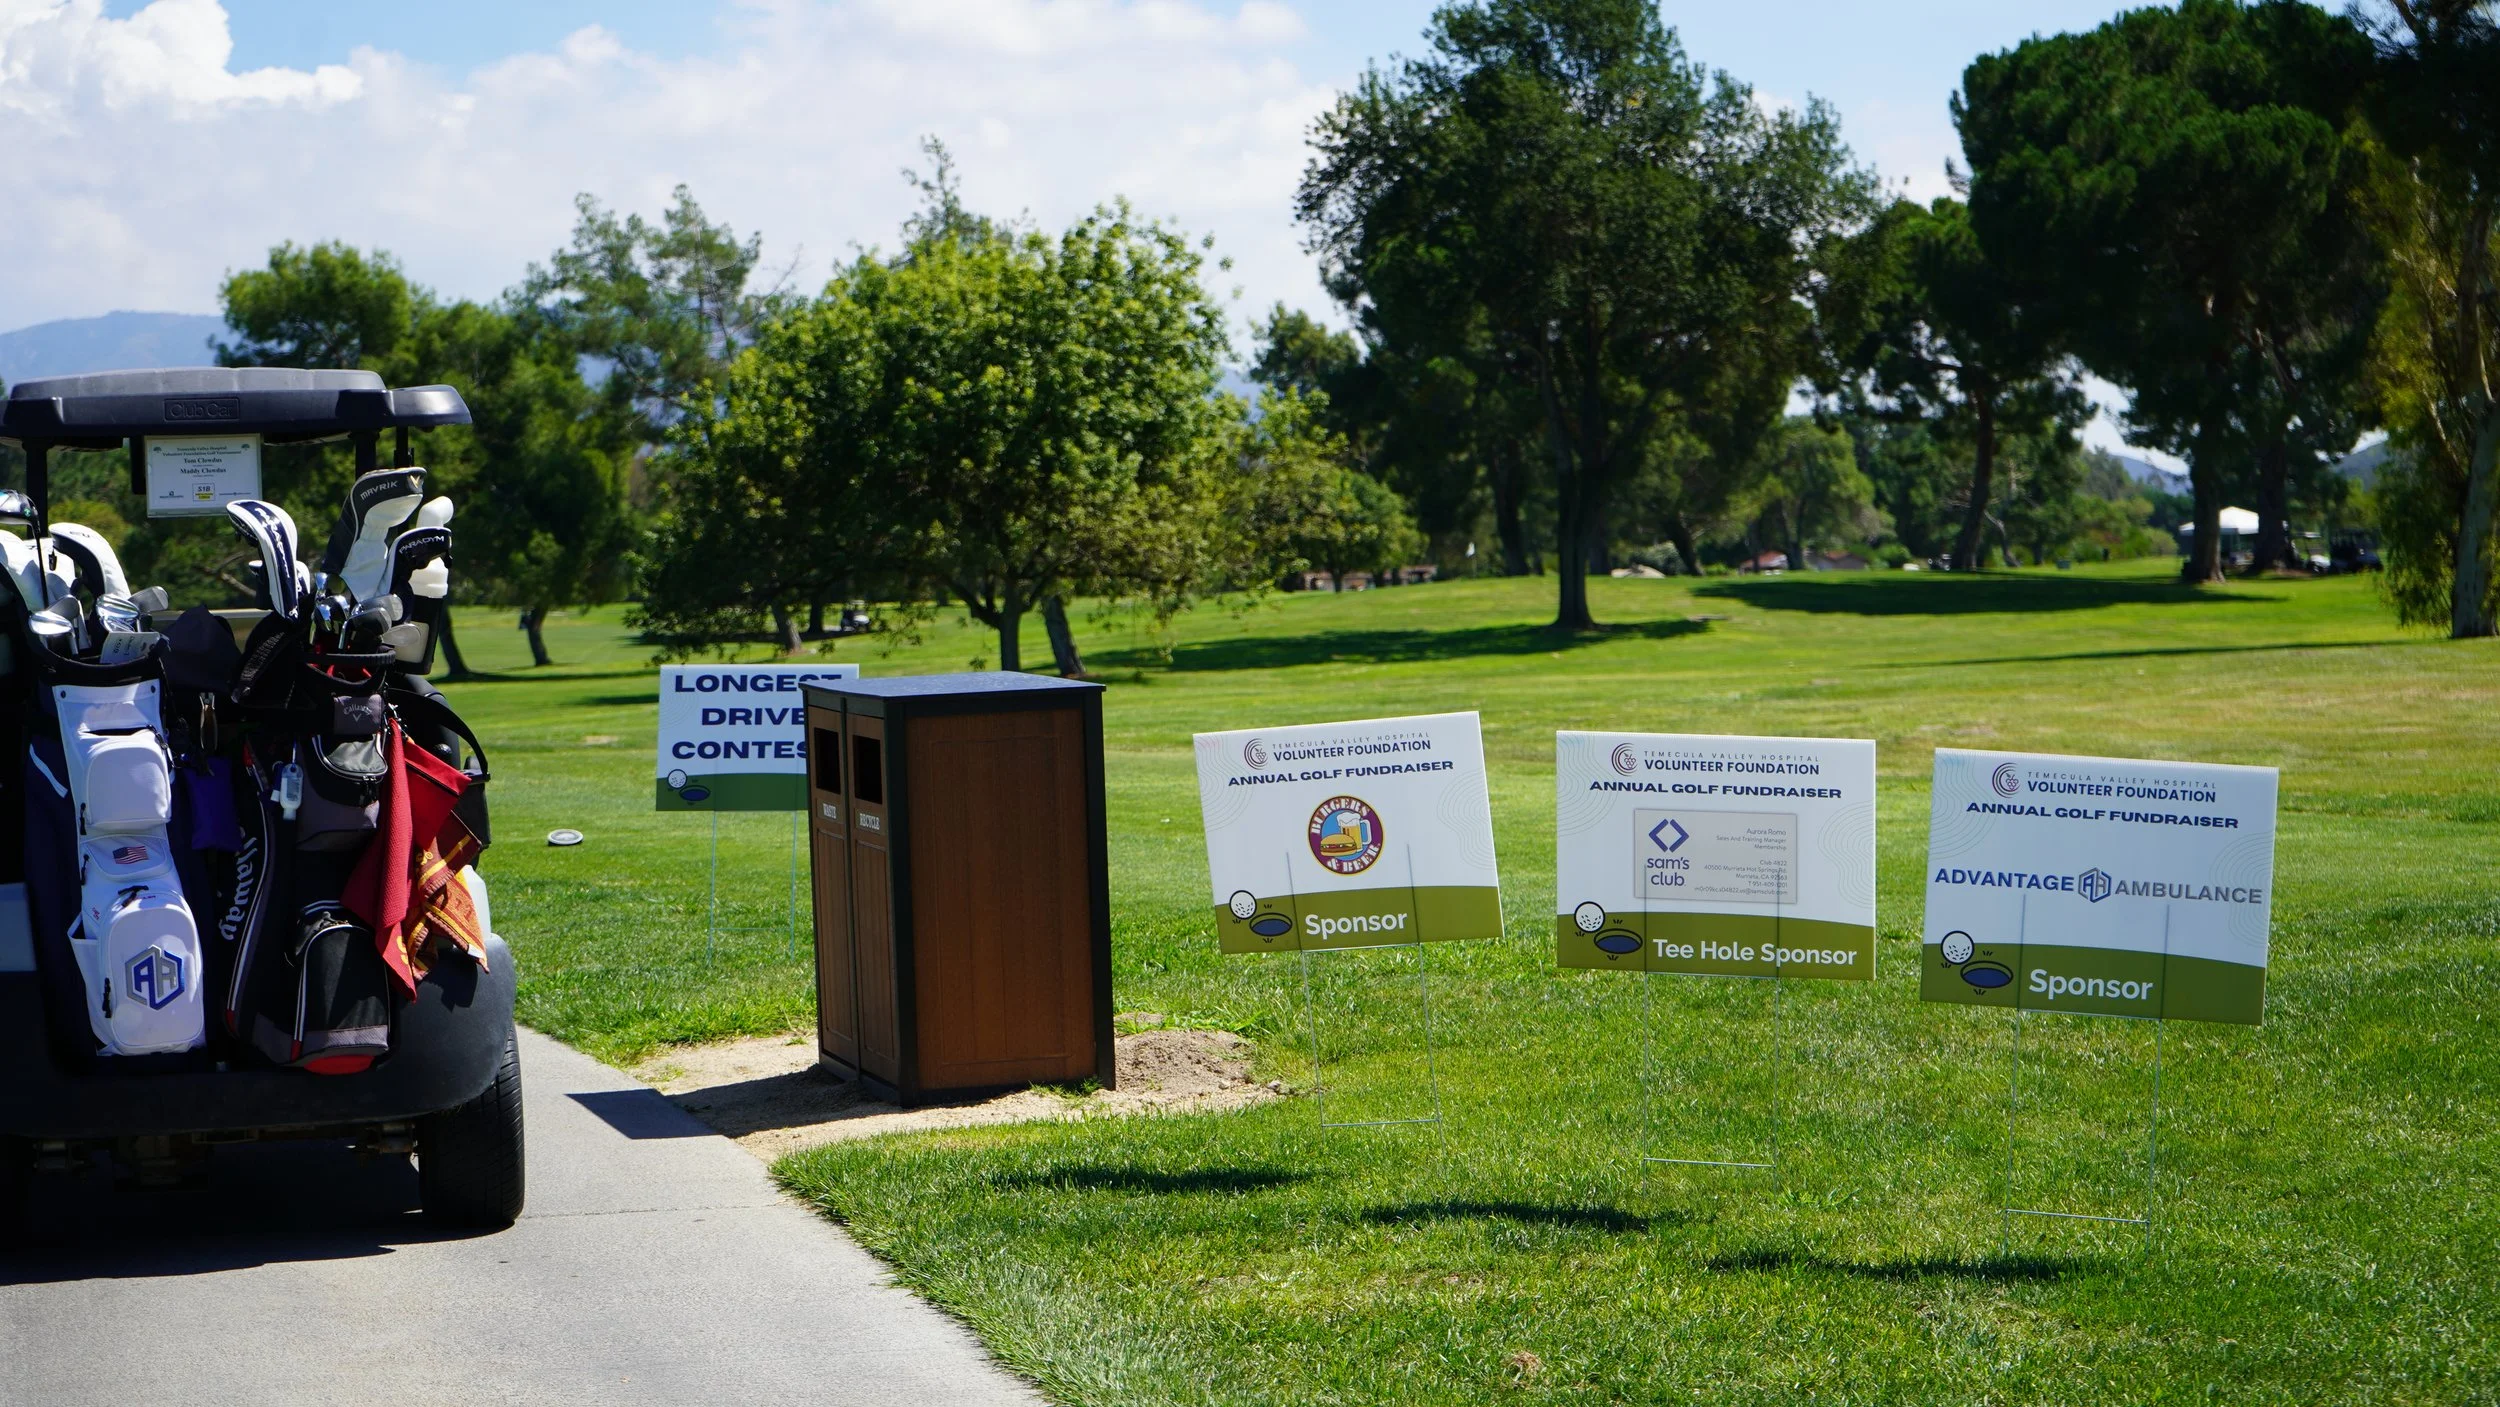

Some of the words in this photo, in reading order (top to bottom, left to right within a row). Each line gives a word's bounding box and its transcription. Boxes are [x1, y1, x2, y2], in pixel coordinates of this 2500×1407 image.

[170, 403, 203, 418] Club
[207, 403, 232, 417] Car
[360, 480, 398, 501] MAVRIK
[399, 535, 445, 554] PARADYM
[675, 674, 842, 693] LONGE
[1272, 740, 1325, 749] TEMECULA
[1333, 736, 1370, 745] VALLEY
[1378, 732, 1430, 740] HOSPITAL
[1273, 747, 1345, 762] VOLUNTEER
[1349, 740, 1431, 756] FOUNDATION
[1228, 772, 1298, 787] ANNUAL
[1301, 769, 1342, 780] GOLF
[1346, 760, 1454, 778] FUNDRAISER
[1644, 759, 1724, 772] VOLUNTEER
[1727, 762, 1820, 775] FOUNDATION
[1589, 781, 1668, 793] ANNUAL
[1672, 784, 1719, 795] GOLF
[1722, 785, 1842, 799] FUNDRAISER
[2028, 772, 2092, 781] TEMECULA
[2101, 776, 2145, 785] VALLEY
[2154, 779, 2216, 789] HOSPITAL
[2027, 780, 2112, 797] VOLUNTEER
[2116, 786, 2216, 803] FOUNDATION
[823, 803, 837, 819] WASTE
[859, 813, 880, 830] RECYCLE
[1310, 798, 1370, 834] BURGERS
[1966, 802, 2052, 817] ANNUAL
[2055, 807, 2106, 820] GOLF
[2109, 810, 2239, 828] FUNDRAISER
[1342, 843, 1379, 872] BEER
[219, 826, 257, 941] llaway
[1650, 872, 1685, 886] club
[1934, 868, 2075, 892] ADVANTAGE
[2115, 880, 2263, 904] AMBULANCE
[1304, 911, 1408, 940] Sponsor
[1652, 938, 1694, 959] Tee
[1700, 941, 1755, 962] Hole
[1760, 943, 1858, 968] Sponsor
[2028, 968, 2153, 1000] Sponsor
